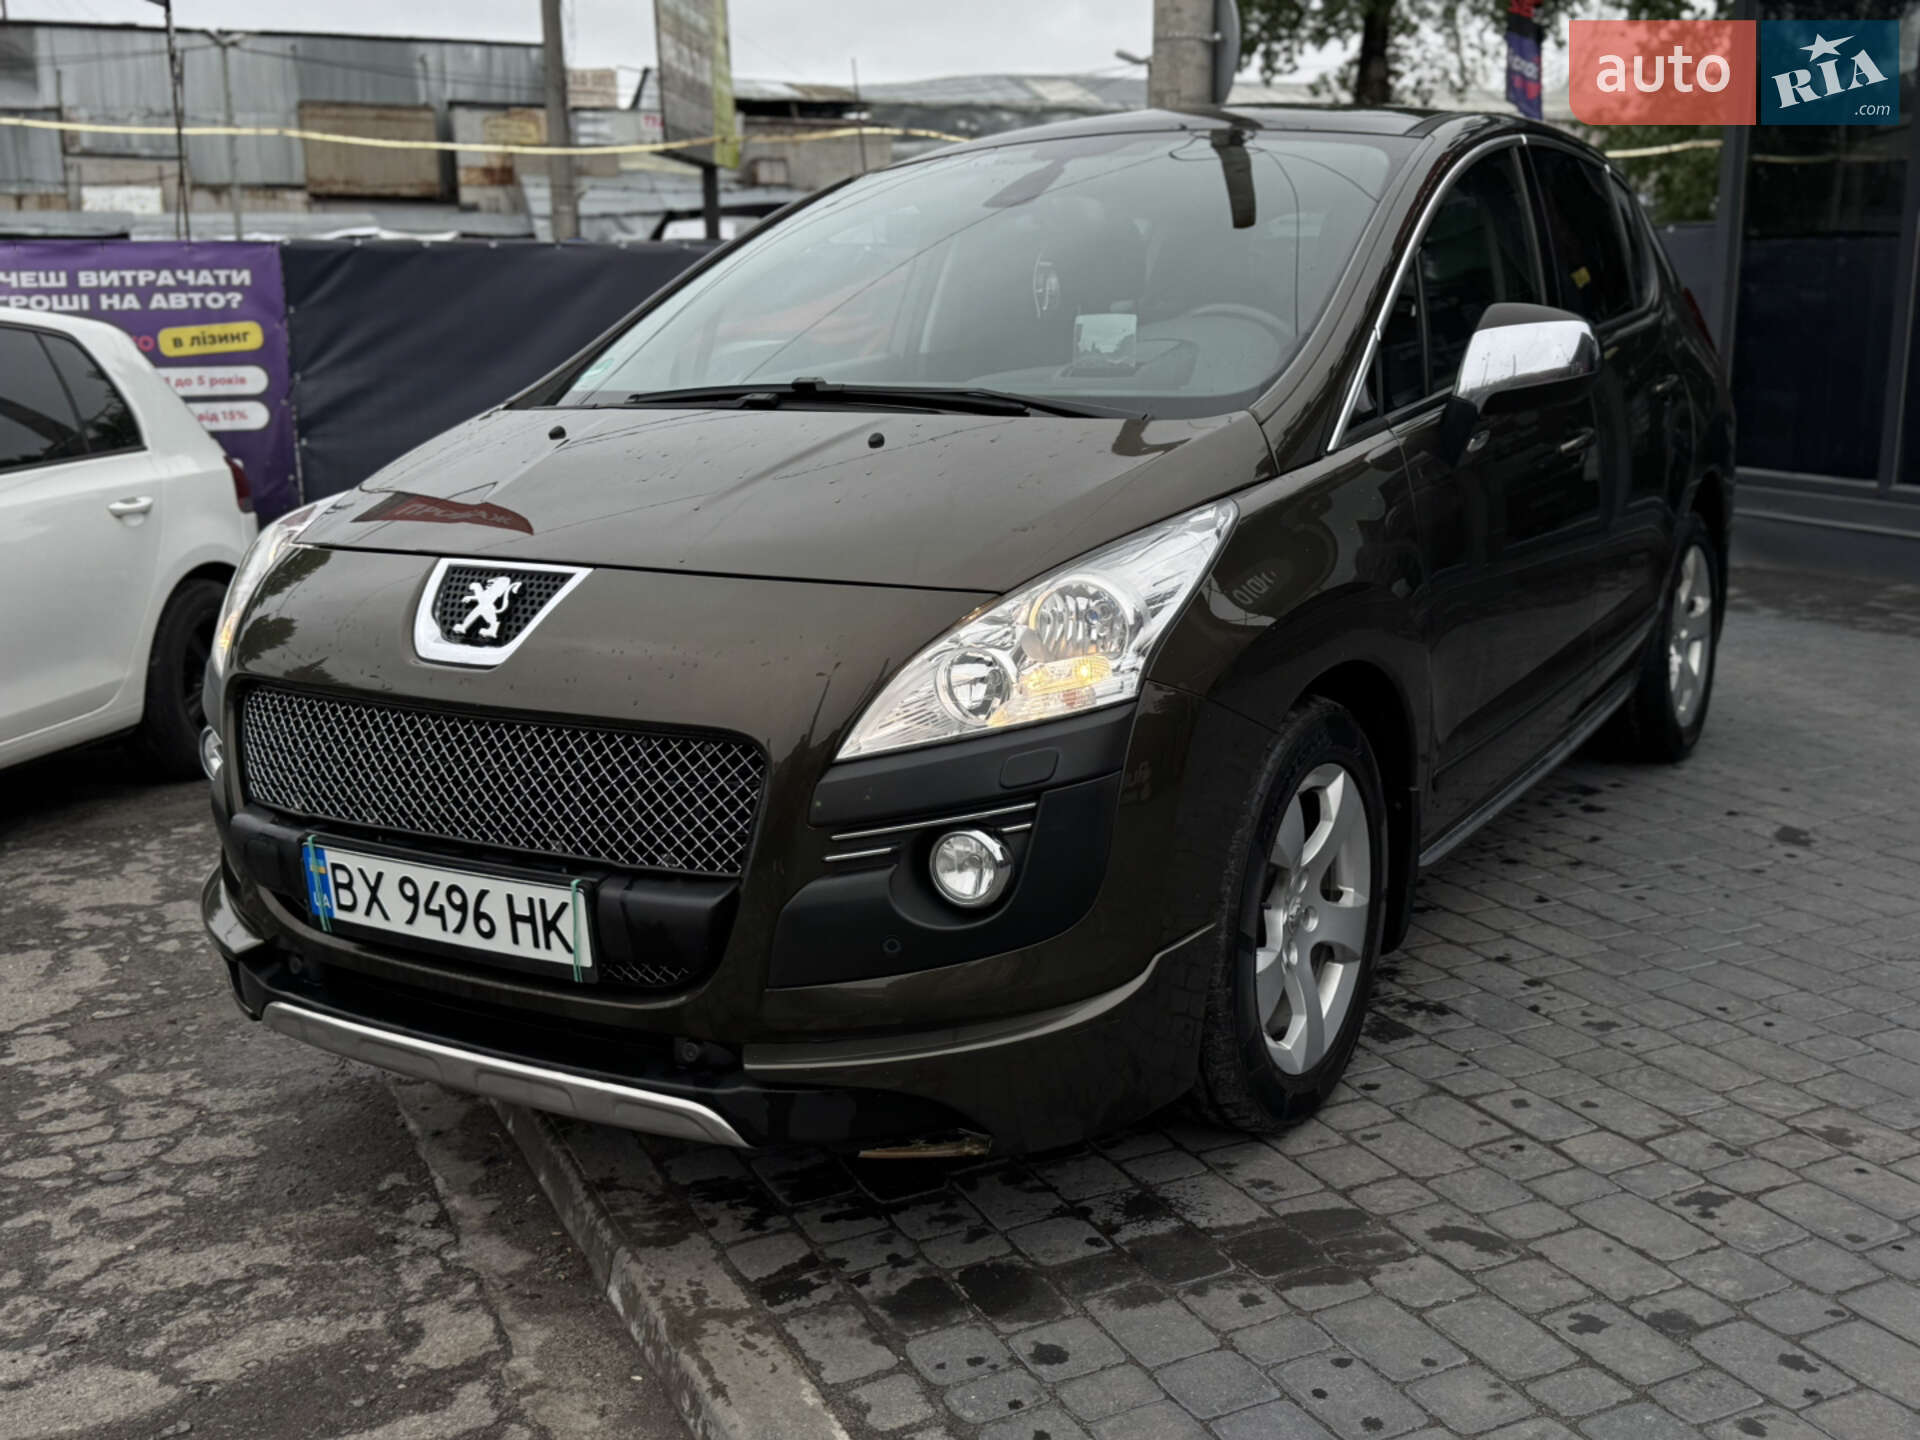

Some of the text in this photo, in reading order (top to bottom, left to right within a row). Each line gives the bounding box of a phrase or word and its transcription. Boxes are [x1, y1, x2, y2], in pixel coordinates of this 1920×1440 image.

[78, 270, 251, 288] ВИТРАЧАТИ
[0, 292, 243, 311] РОШІ НА АВТО?
[189, 332, 249, 347] лізинг
[175, 377, 193, 388] до
[197, 375, 205, 386] 5
[209, 375, 247, 388] років
[398, 875, 497, 939] 9496
